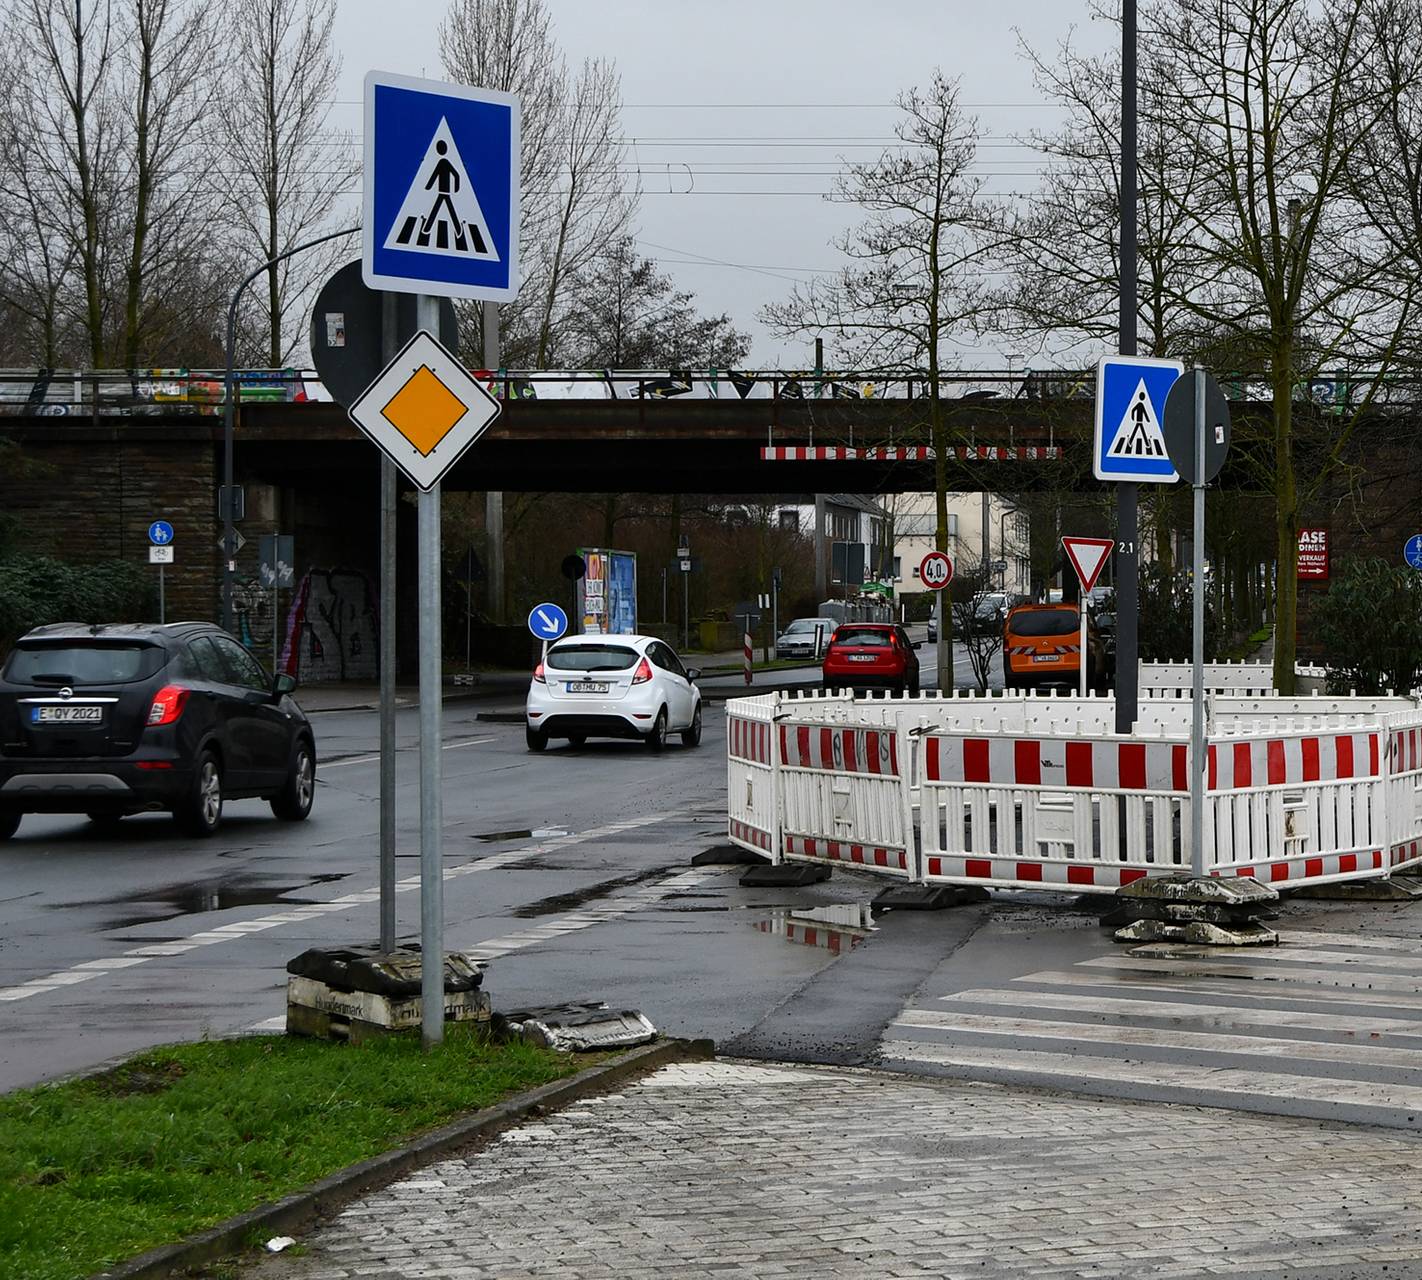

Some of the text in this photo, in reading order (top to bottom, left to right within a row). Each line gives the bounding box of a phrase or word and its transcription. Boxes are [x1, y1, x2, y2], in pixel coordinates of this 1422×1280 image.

[1119, 541, 1133, 553] 2.1
[40, 708, 47, 719] E
[72, 708, 100, 719] 2021
